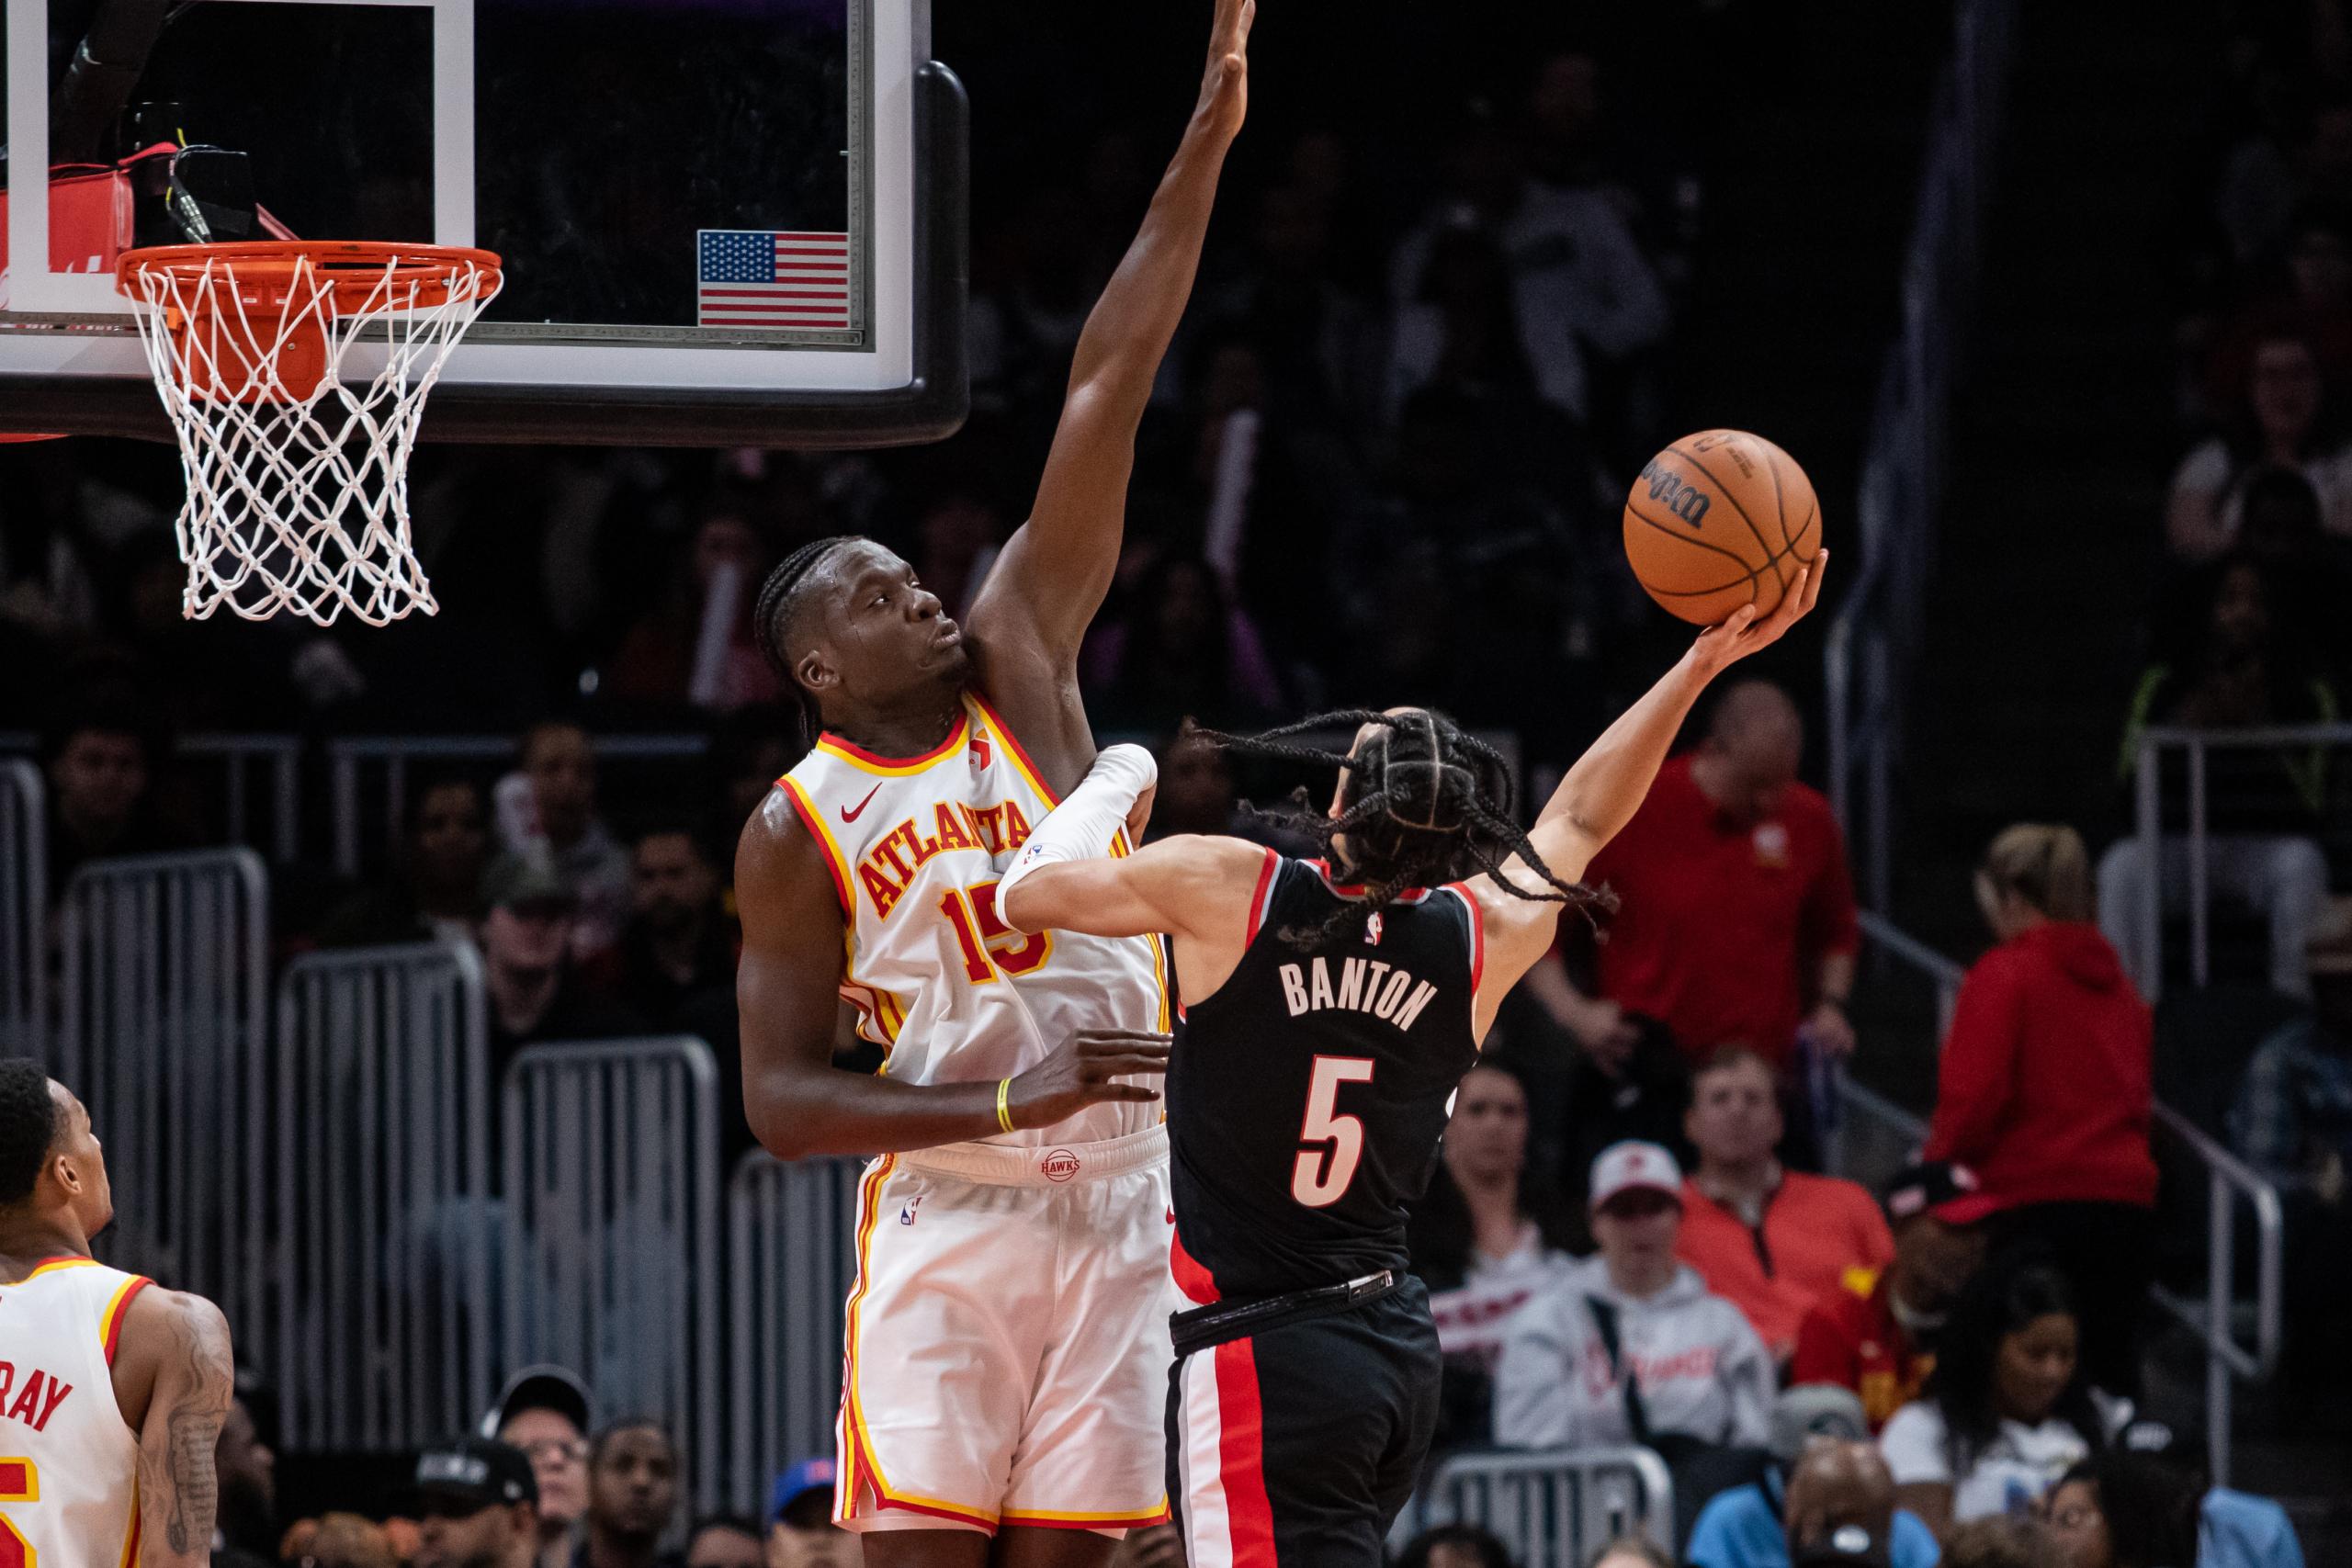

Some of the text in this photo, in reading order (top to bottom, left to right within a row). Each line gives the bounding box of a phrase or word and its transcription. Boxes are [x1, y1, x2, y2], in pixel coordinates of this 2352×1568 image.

[938, 879, 1055, 986] 15
[1279, 956, 1438, 1032] BANTON
[1041, 1159, 1080, 1173] HAWKS
[1291, 1054, 1375, 1209] 5
